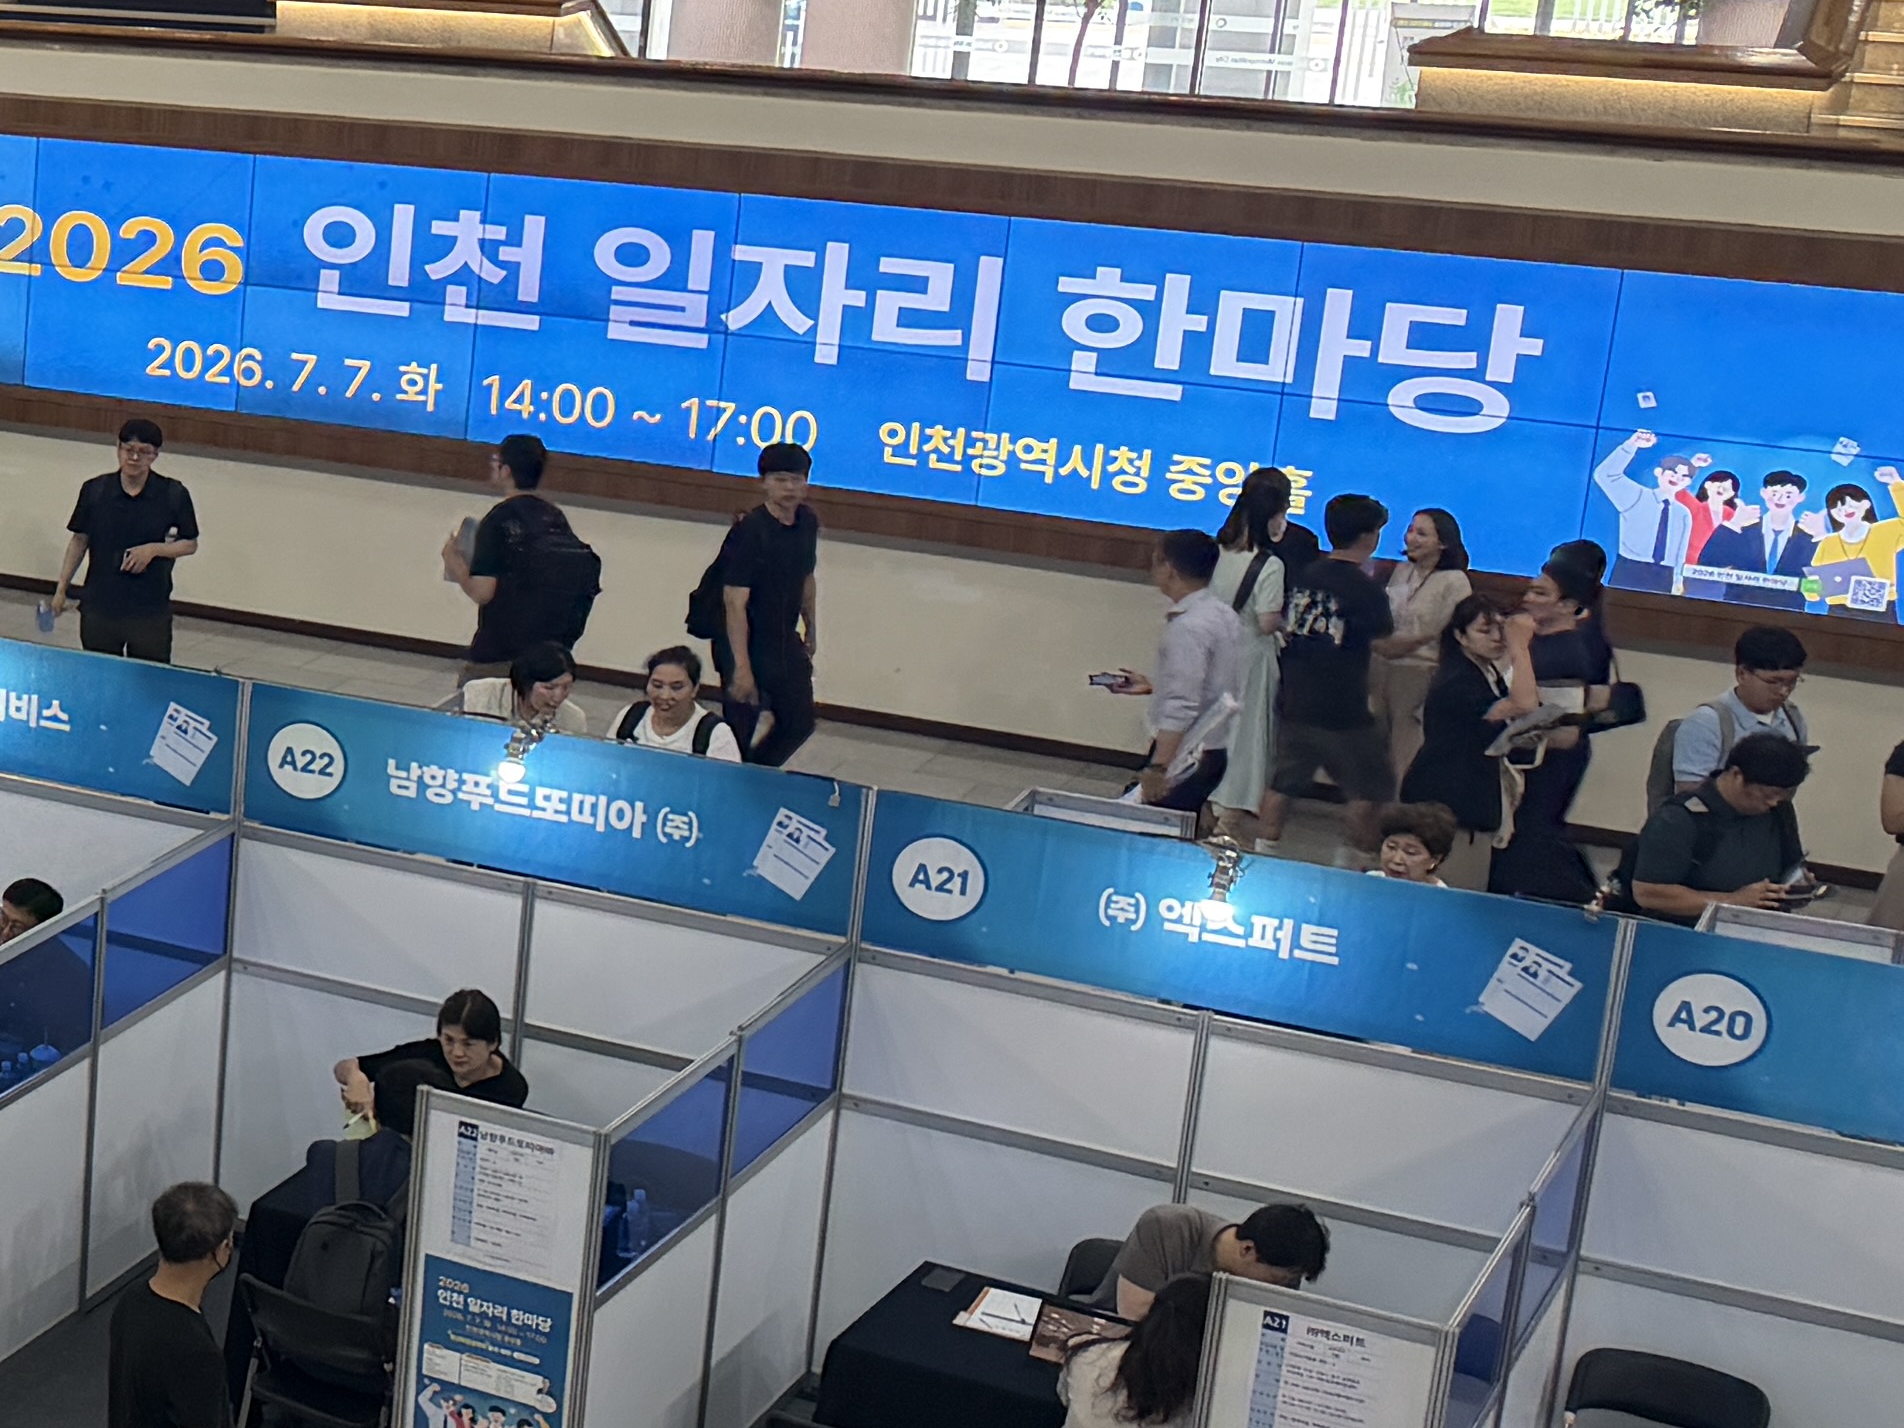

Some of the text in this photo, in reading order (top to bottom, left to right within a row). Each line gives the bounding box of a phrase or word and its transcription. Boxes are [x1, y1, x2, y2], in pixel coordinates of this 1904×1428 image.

[302, 201, 547, 332] 인천
[591, 224, 1004, 383] 일자리
[1055, 265, 1545, 435] 한마당
[396, 362, 443, 415] 화
[481, 373, 616, 431] 14:00
[680, 398, 818, 454] 17:00
[877, 420, 1152, 494] 인천광역시청
[278, 747, 336, 777] A22
[387, 756, 700, 848] 남향푸드또띠아 (주)
[908, 861, 970, 897] A21
[1097, 887, 1340, 967] (주) 엑스퍼트
[1665, 999, 1754, 1043] A20
[437, 1289, 464, 1310] 인천
[467, 1297, 507, 1322] 일자리
[1263, 1315, 1287, 1329] A21
